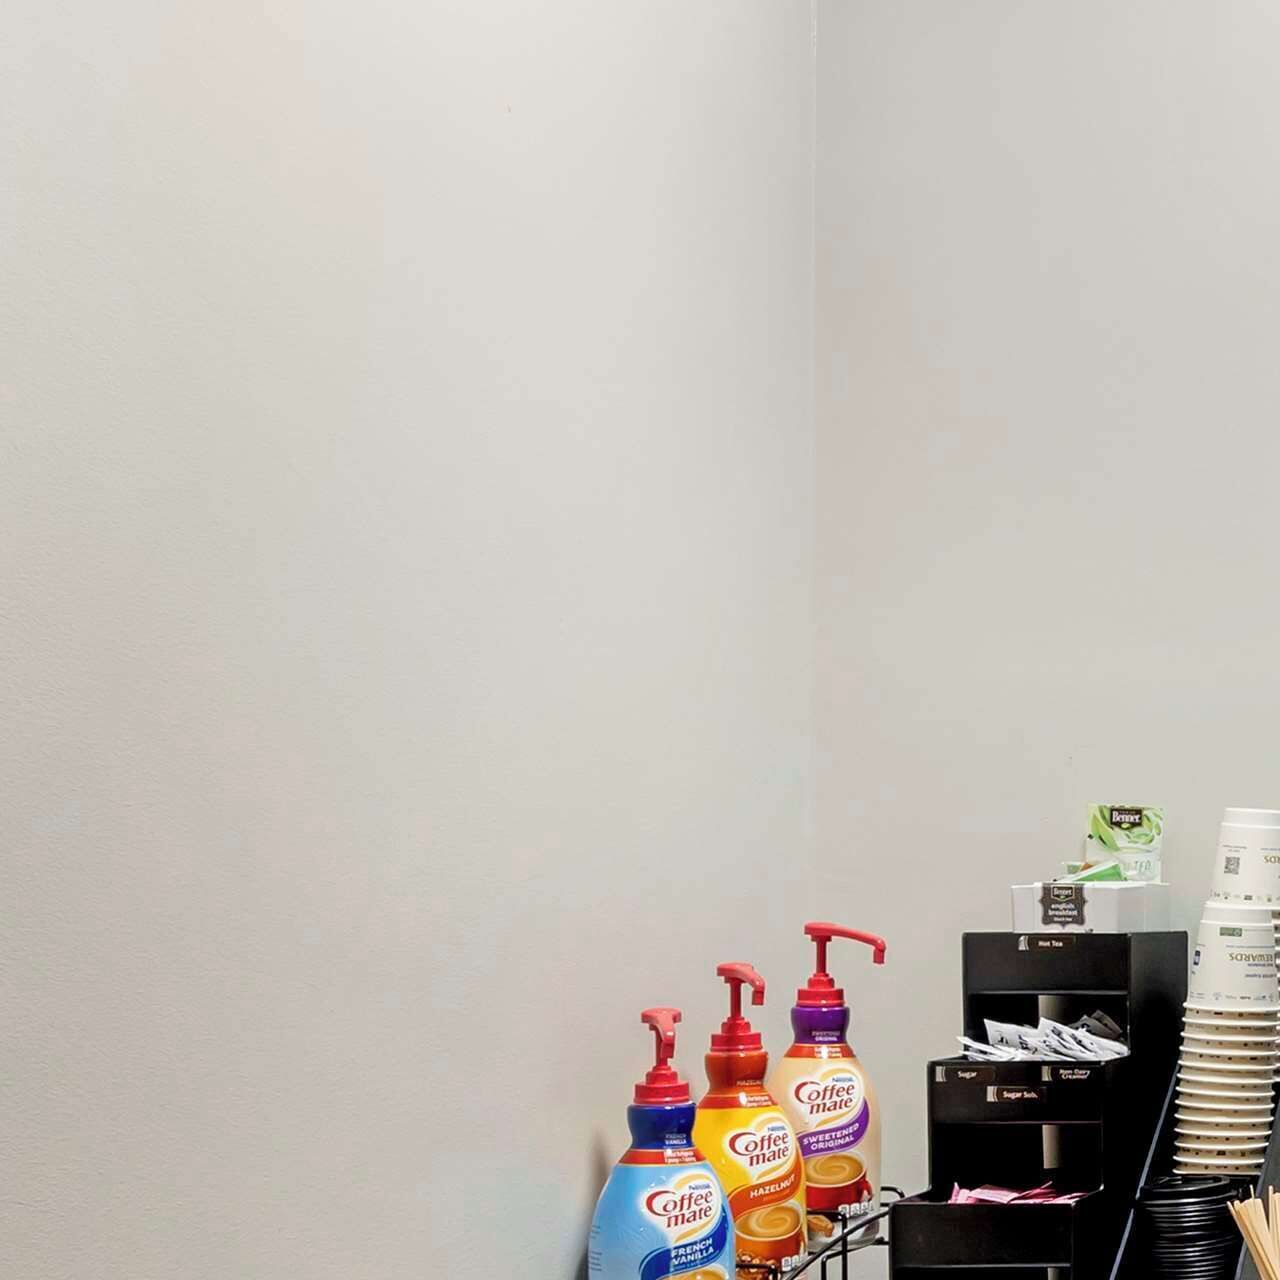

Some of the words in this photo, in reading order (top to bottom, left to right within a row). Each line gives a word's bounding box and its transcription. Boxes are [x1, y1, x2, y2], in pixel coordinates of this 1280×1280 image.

[957, 1070, 977, 1079] Sugar
[794, 1081, 855, 1104] Coffee
[1003, 1091, 1022, 1099] Sugar
[809, 1096, 853, 1115] mate
[729, 1131, 789, 1156] Coffee
[803, 1122, 859, 1145] SWEETENED
[811, 1135, 854, 1150] ORIGINAL
[749, 1145, 788, 1167] mate
[750, 1174, 795, 1199] HAZELNUT
[645, 1188, 713, 1217] Coffee
[666, 1203, 712, 1228] mate
[671, 1237, 712, 1258] FRENCH
[672, 1247, 714, 1265] VANILLA
